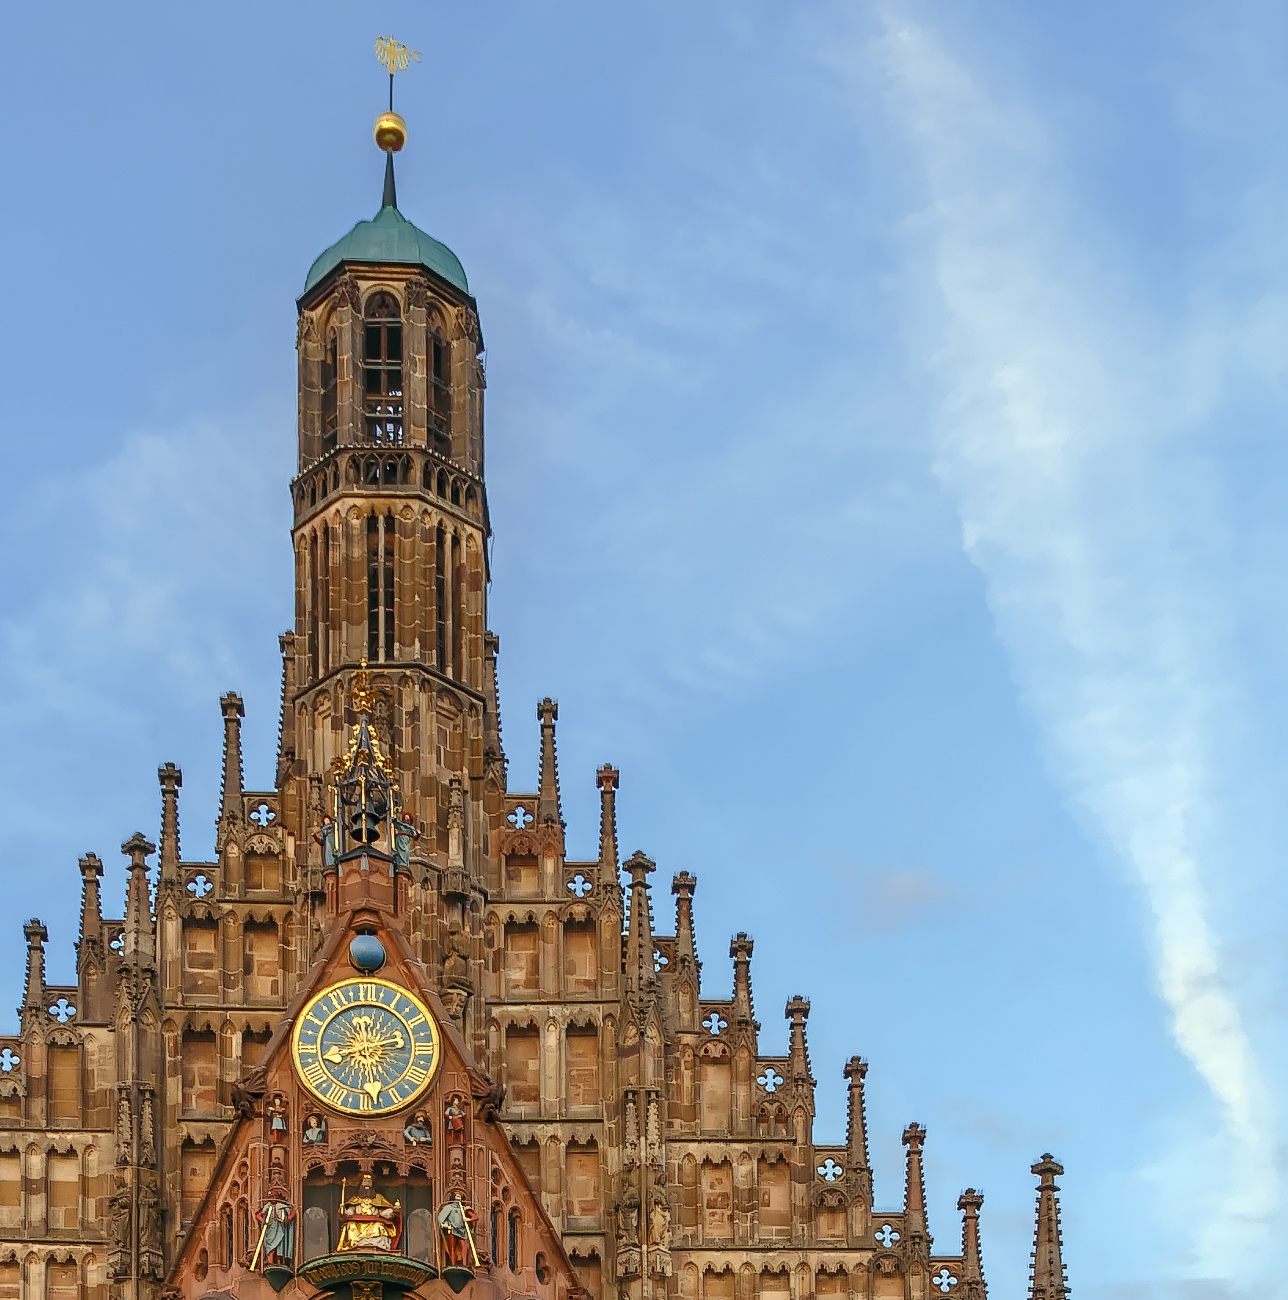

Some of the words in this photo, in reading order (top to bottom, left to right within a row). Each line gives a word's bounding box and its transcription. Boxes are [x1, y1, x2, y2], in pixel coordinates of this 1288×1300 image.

[327, 988, 348, 1009] XI
[358, 983, 377, 1002] XII
[389, 992, 402, 1009] I
[305, 1011, 324, 1026] X
[408, 1013, 426, 1029] II
[415, 1042, 433, 1055] III
